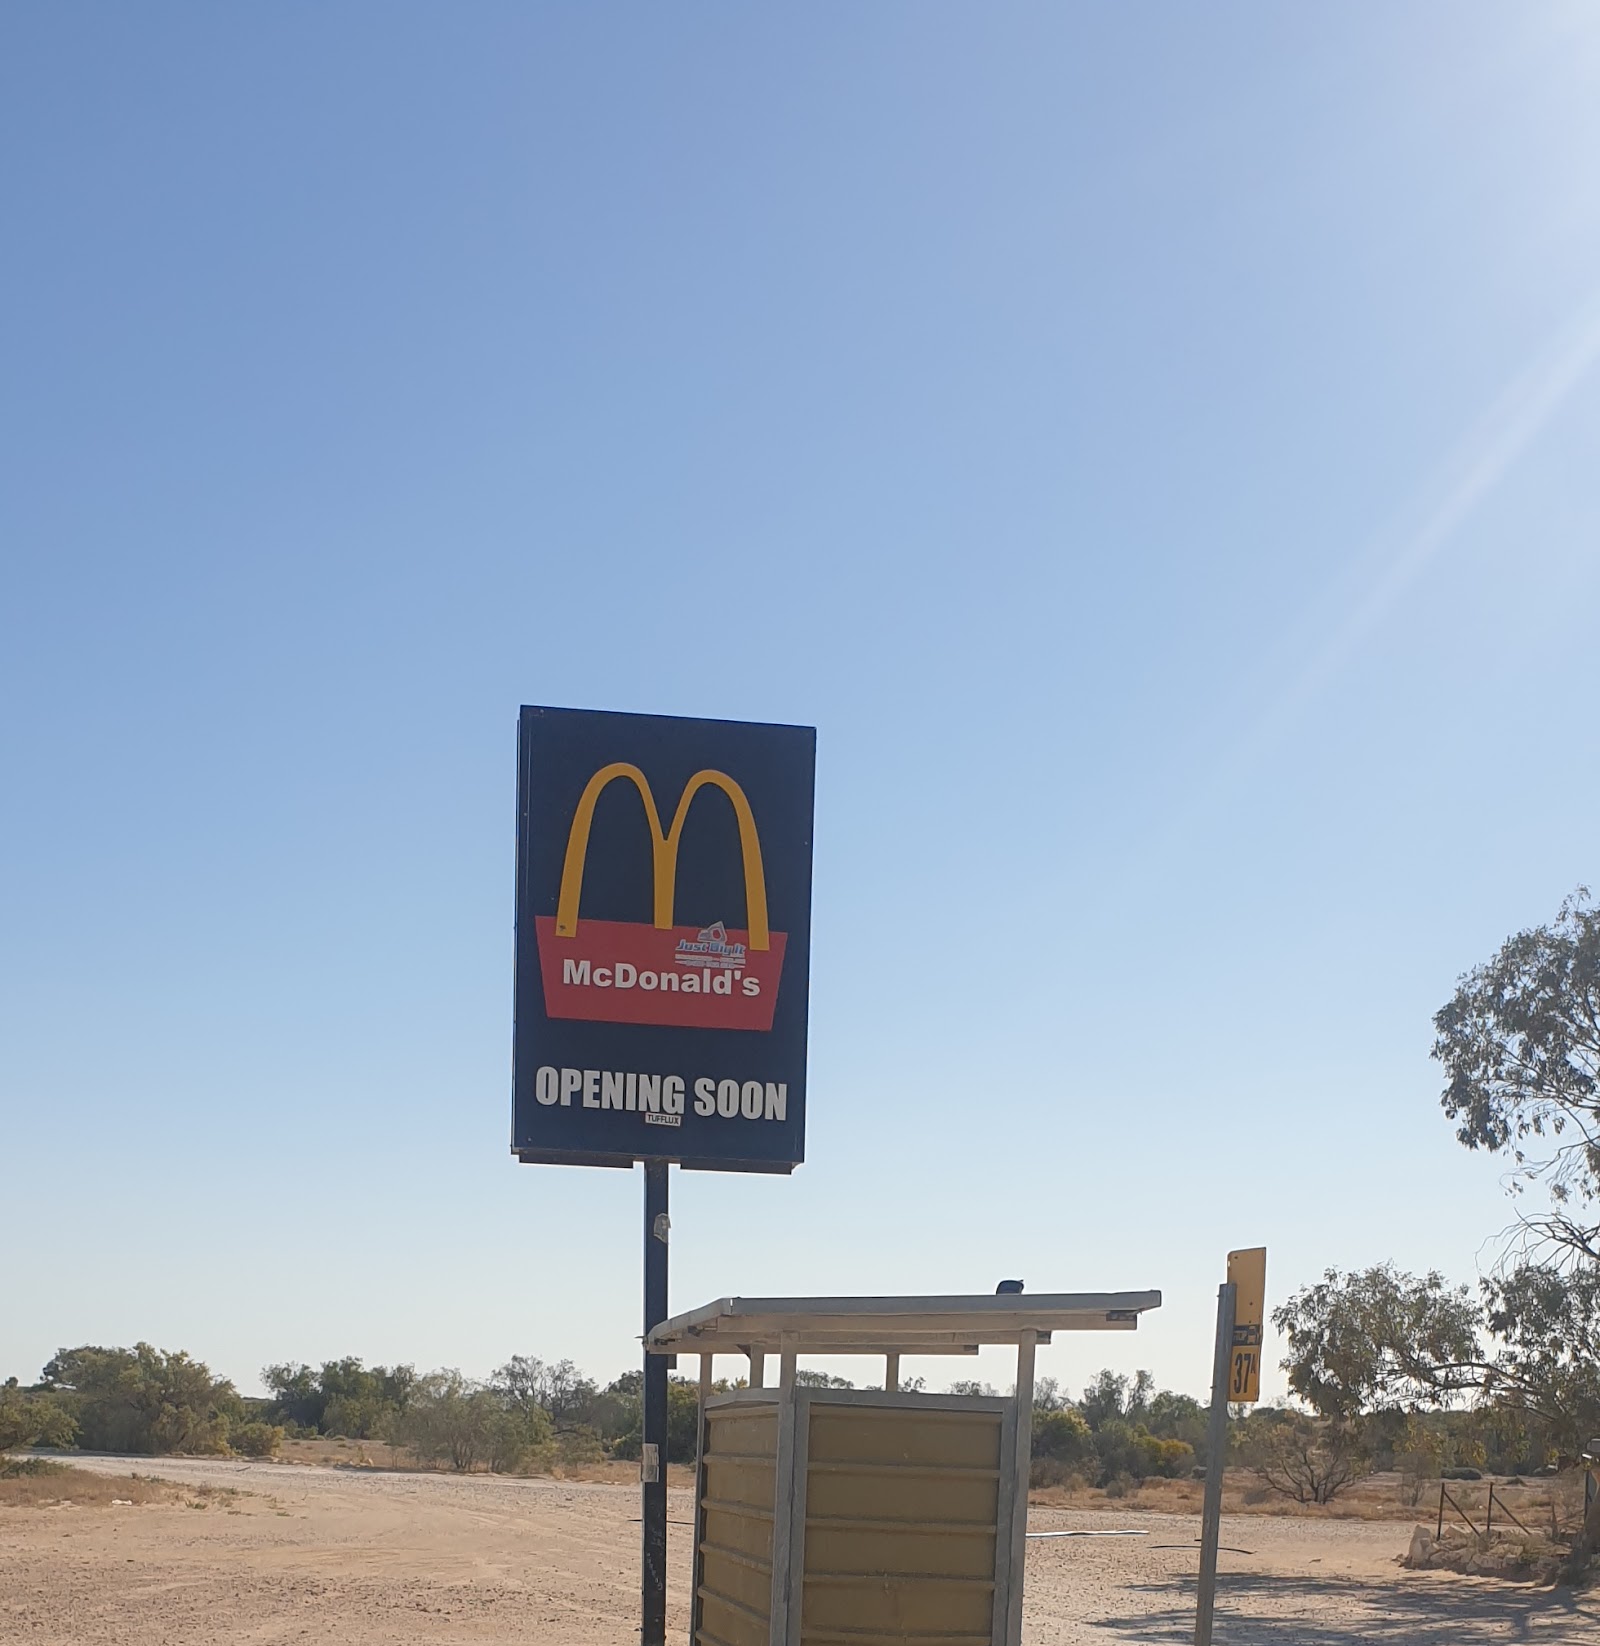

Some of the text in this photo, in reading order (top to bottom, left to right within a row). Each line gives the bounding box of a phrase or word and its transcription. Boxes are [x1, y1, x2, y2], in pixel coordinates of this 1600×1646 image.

[563, 959, 760, 996] McDonald's
[535, 1066, 787, 1121] OPENING SOON
[647, 1114, 679, 1125] TUFFLUX
